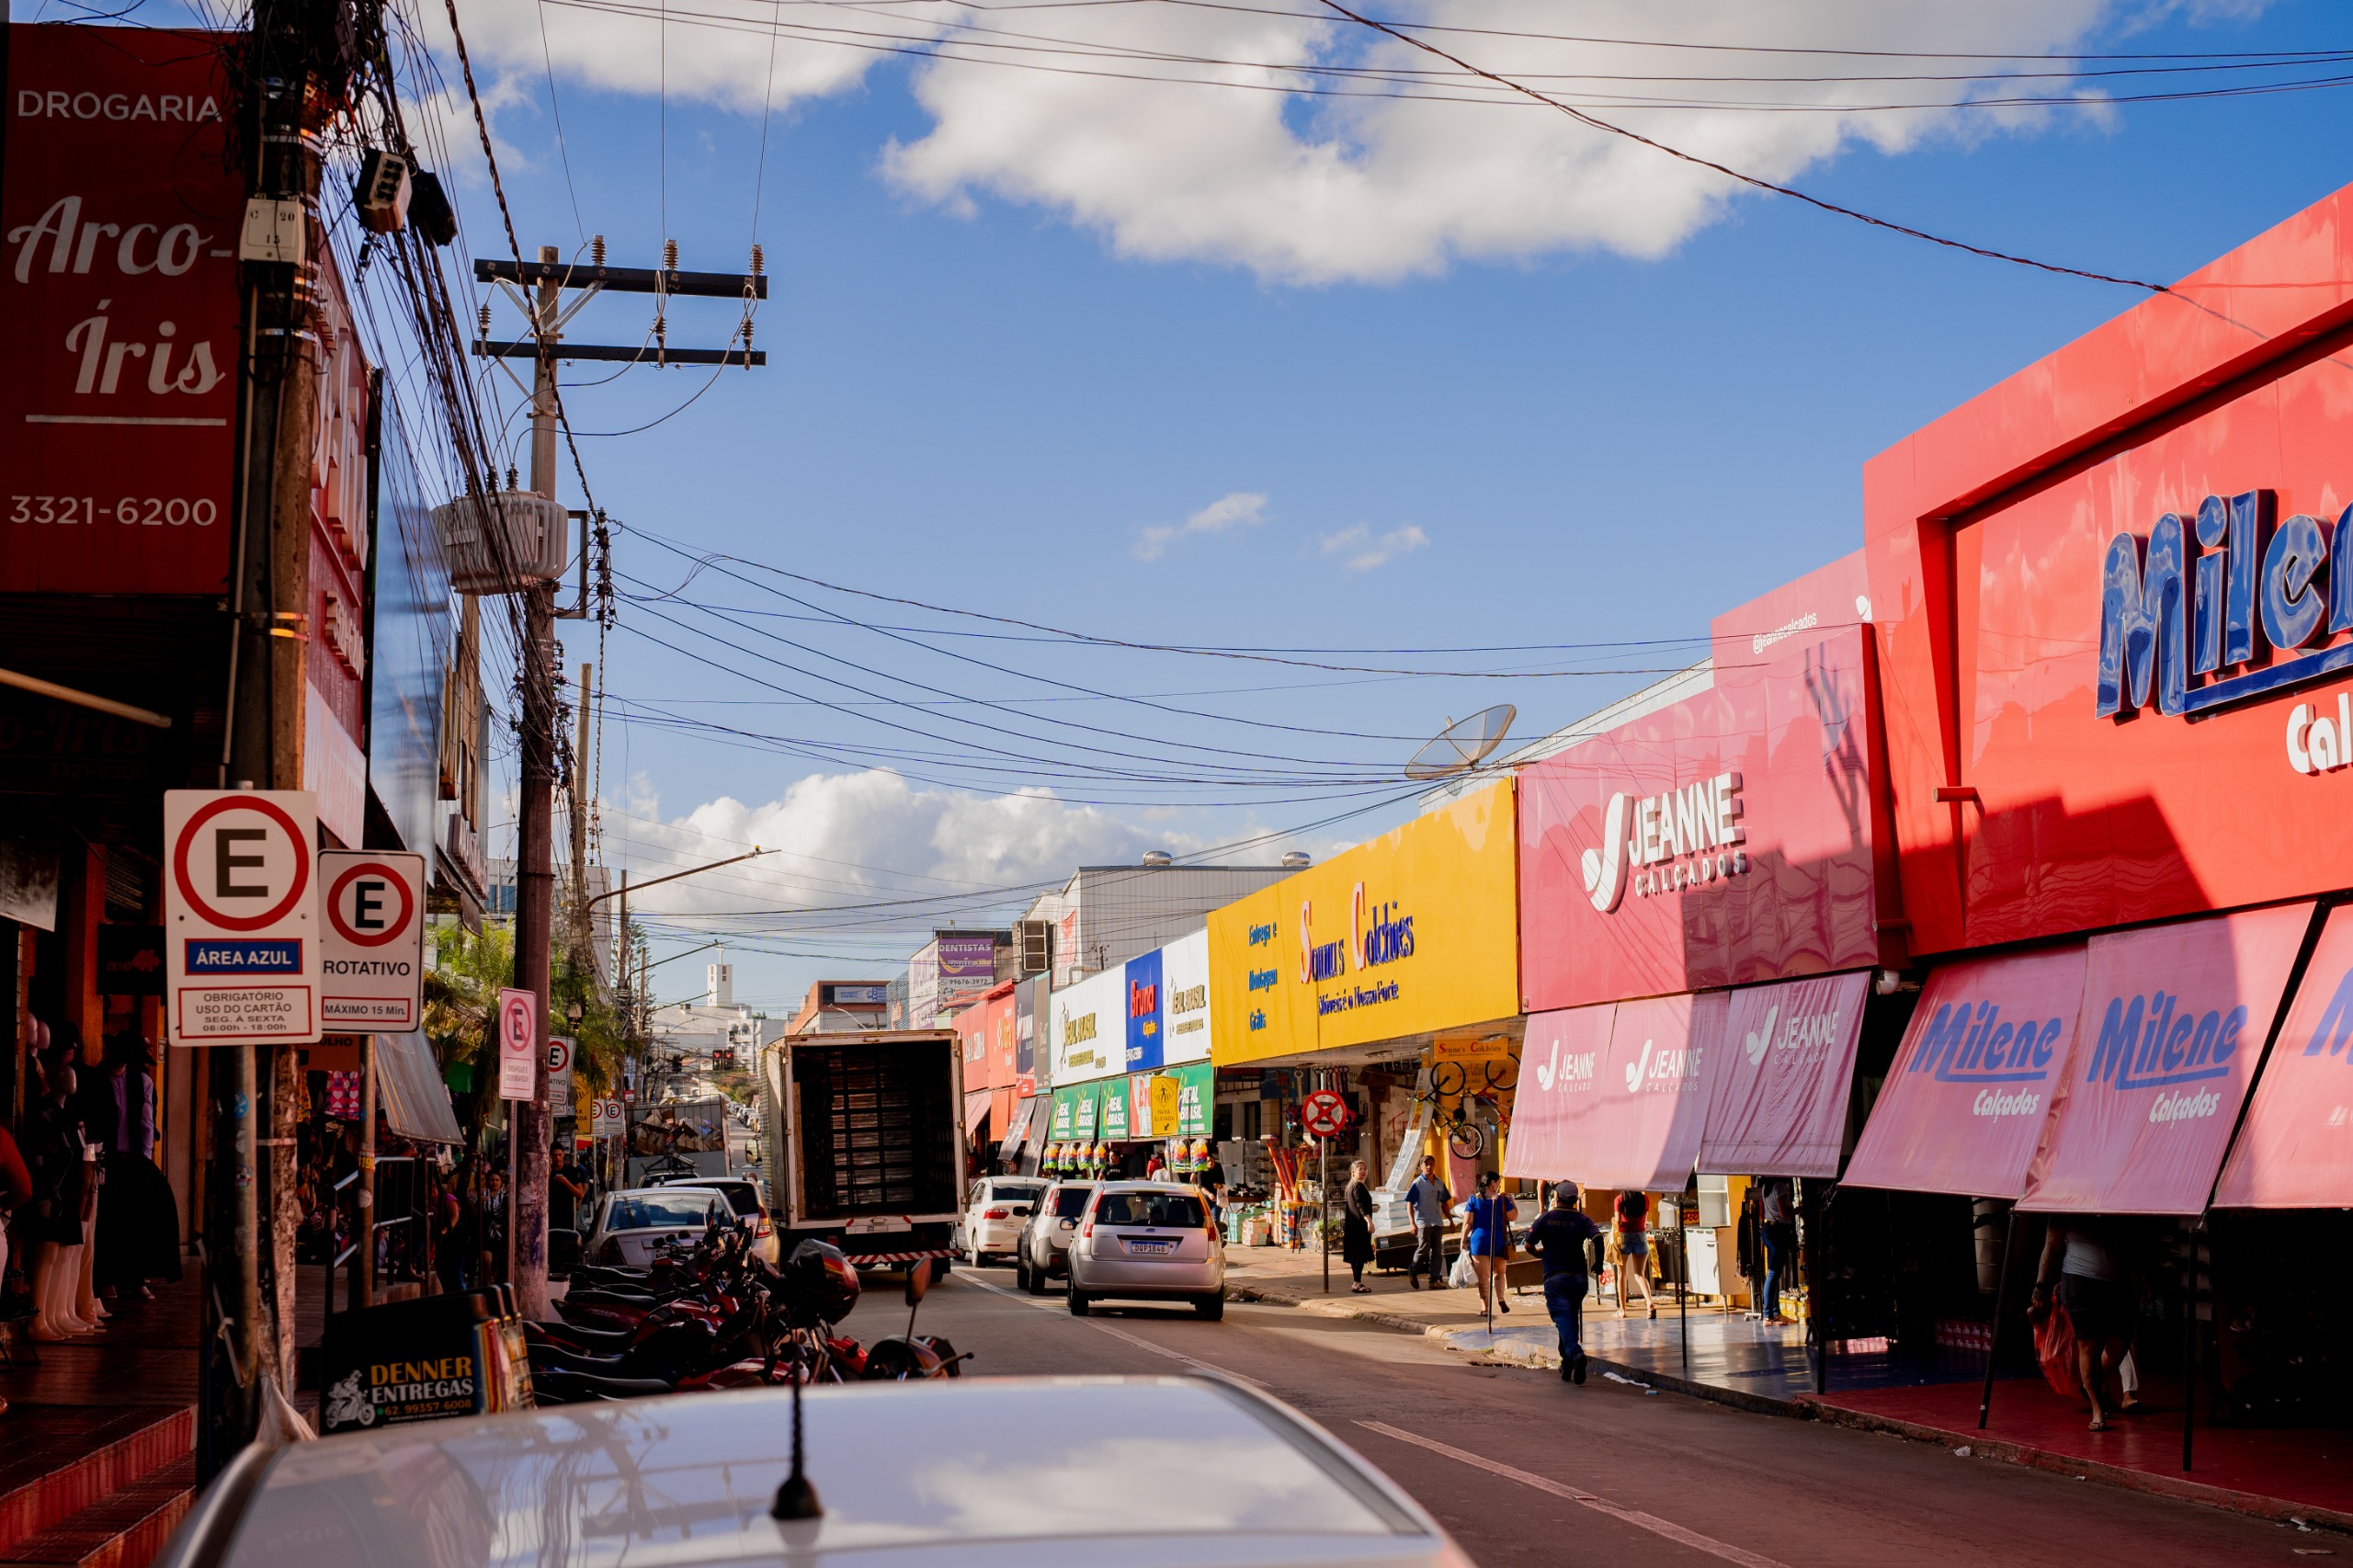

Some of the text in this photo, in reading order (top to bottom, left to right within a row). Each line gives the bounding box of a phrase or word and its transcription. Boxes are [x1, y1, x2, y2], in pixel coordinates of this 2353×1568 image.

[17, 90, 223, 122] DROGARIA
[279, 212, 295, 222] 20
[7, 195, 233, 284] Arco-
[65, 299, 227, 395] Íris
[9, 495, 217, 527] 3321-6200
[1628, 772, 1745, 868] JEANNE
[215, 829, 268, 897] E
[1635, 849, 1746, 898] CALÇADOS
[355, 881, 385, 928] E
[196, 948, 291, 965] ÁREA AZUL
[938, 943, 992, 952] DENTISTAS
[323, 960, 411, 976] ROTATIVO
[196, 1002, 291, 1014] USO DO CARTÃO
[203, 991, 284, 1002] OBRIGATÓRIO
[324, 1004, 405, 1016] MÁXIMO 15 Min.
[1131, 980, 1156, 1018] Bruna
[202, 1024, 240, 1032] 08:00h
[251, 1023, 287, 1031] 18:00h
[235, 1014, 244, 1022] À
[1777, 1011, 1839, 1051] JEANNE
[1438, 1041, 1501, 1053] Sonnu's Colchões
[1908, 999, 2062, 1083] Milene
[2086, 990, 2248, 1091] Milene
[550, 1048, 561, 1066] E
[1559, 1051, 1596, 1081] JEANNE
[1648, 1047, 1703, 1079] JEANNE
[1645, 1082, 1699, 1094] CALÇADOS
[1972, 1087, 2040, 1123] Calçados
[2149, 1086, 2222, 1130] Calçados
[370, 1357, 472, 1386] DENNER
[371, 1379, 474, 1404] ENTREGAS
